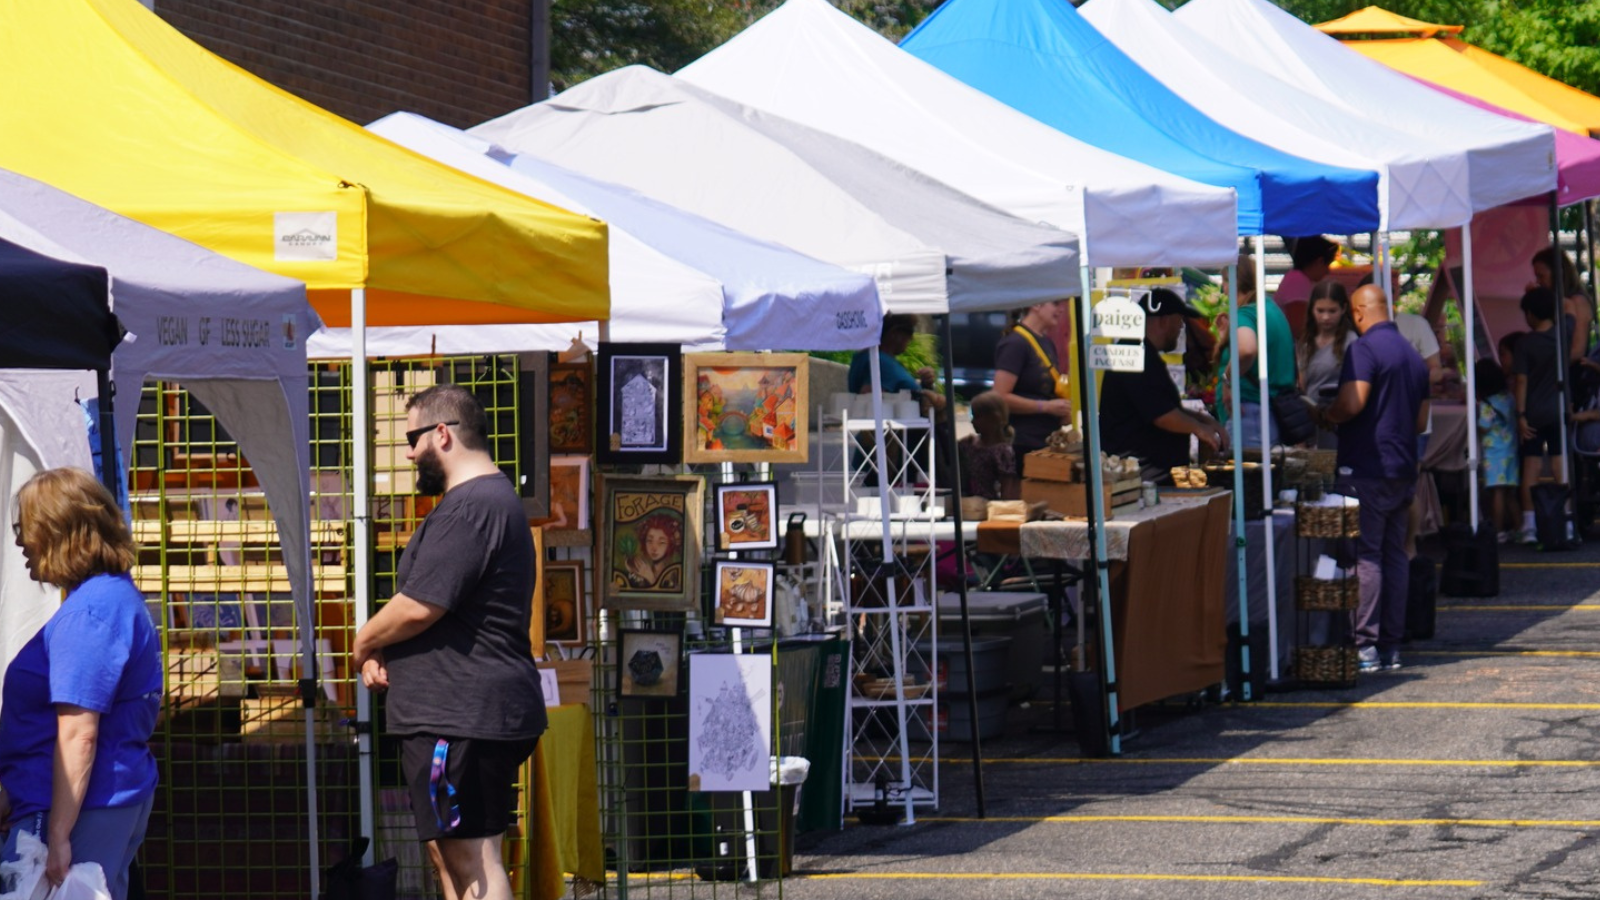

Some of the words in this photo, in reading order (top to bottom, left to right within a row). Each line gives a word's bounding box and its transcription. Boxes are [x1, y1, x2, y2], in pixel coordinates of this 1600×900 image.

[1092, 309, 1142, 329] paige
[157, 316, 188, 345] VEGAN
[221, 318, 240, 347] LESS
[242, 320, 270, 348] SUGAR
[1094, 347, 1139, 357] CANDLES
[1095, 358, 1135, 367] INCENSE
